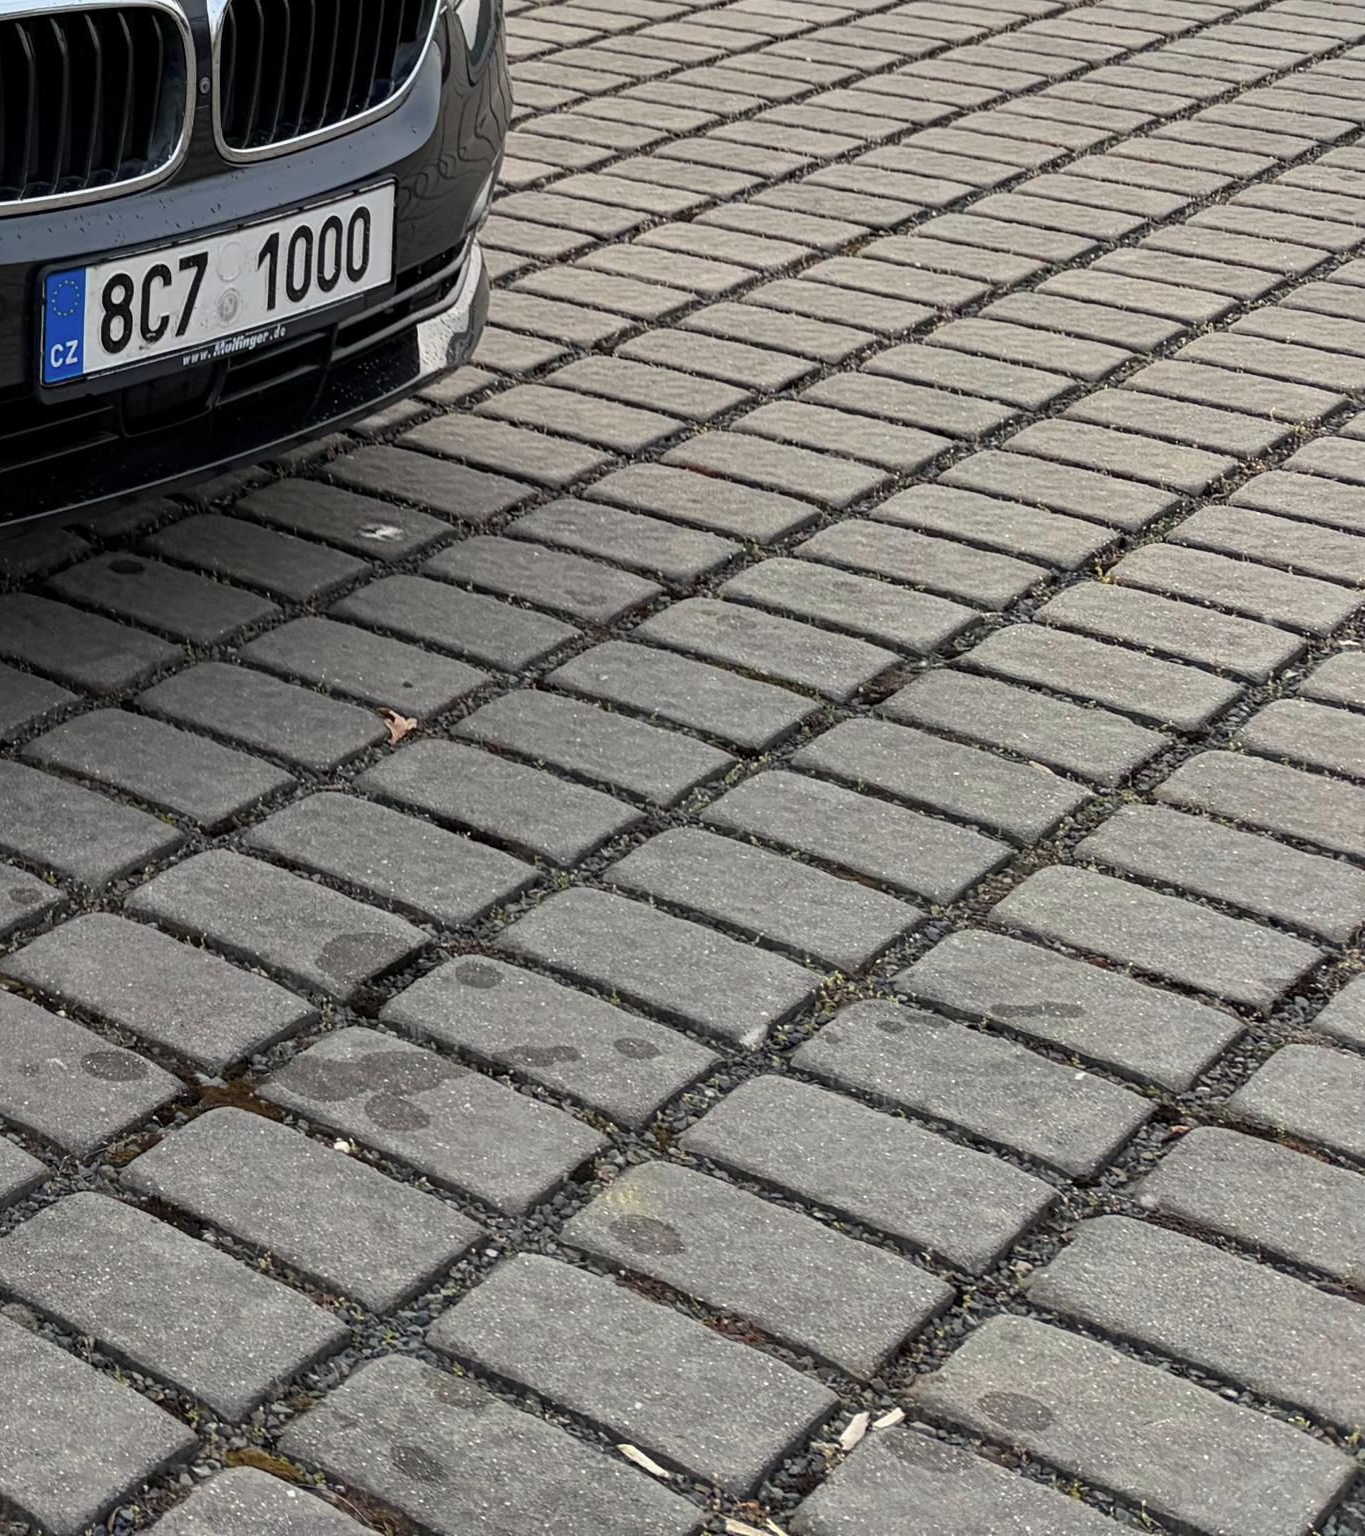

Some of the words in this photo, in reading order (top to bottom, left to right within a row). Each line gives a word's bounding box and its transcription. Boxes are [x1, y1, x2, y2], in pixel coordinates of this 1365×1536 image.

[100, 251, 209, 354] 8C7
[257, 206, 371, 311] 1000
[50, 339, 79, 369] CZ
